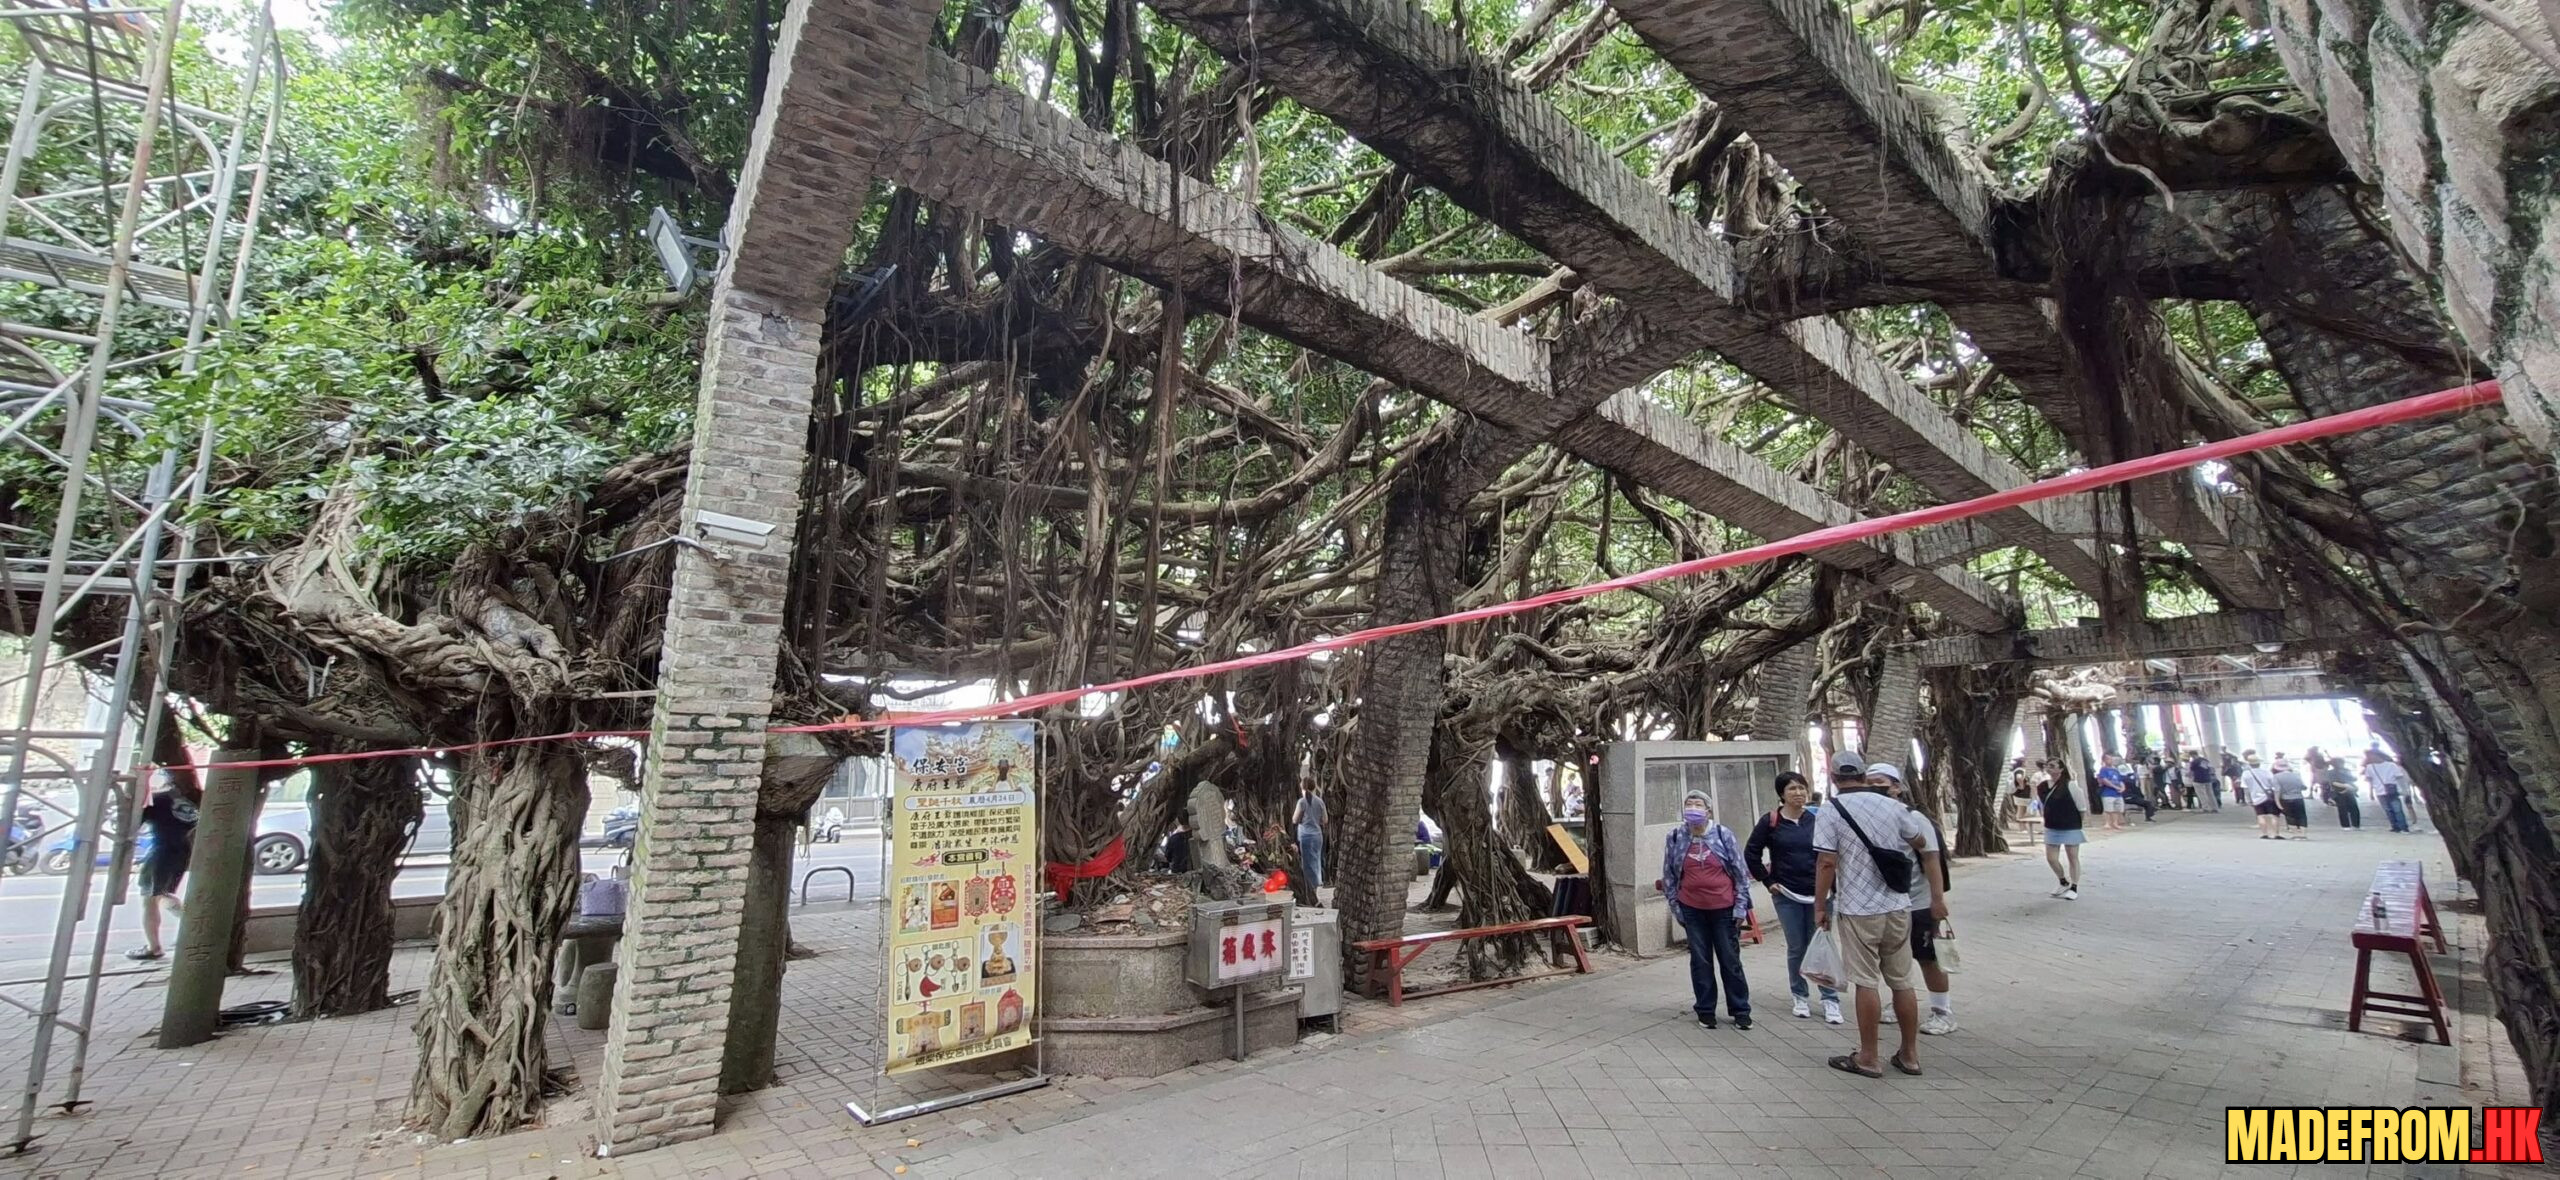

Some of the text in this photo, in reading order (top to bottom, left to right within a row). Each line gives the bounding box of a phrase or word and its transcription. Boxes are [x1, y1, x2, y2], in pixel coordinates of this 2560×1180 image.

[911, 756, 968, 775] 保安宮
[911, 777, 966, 791] 康府王爺
